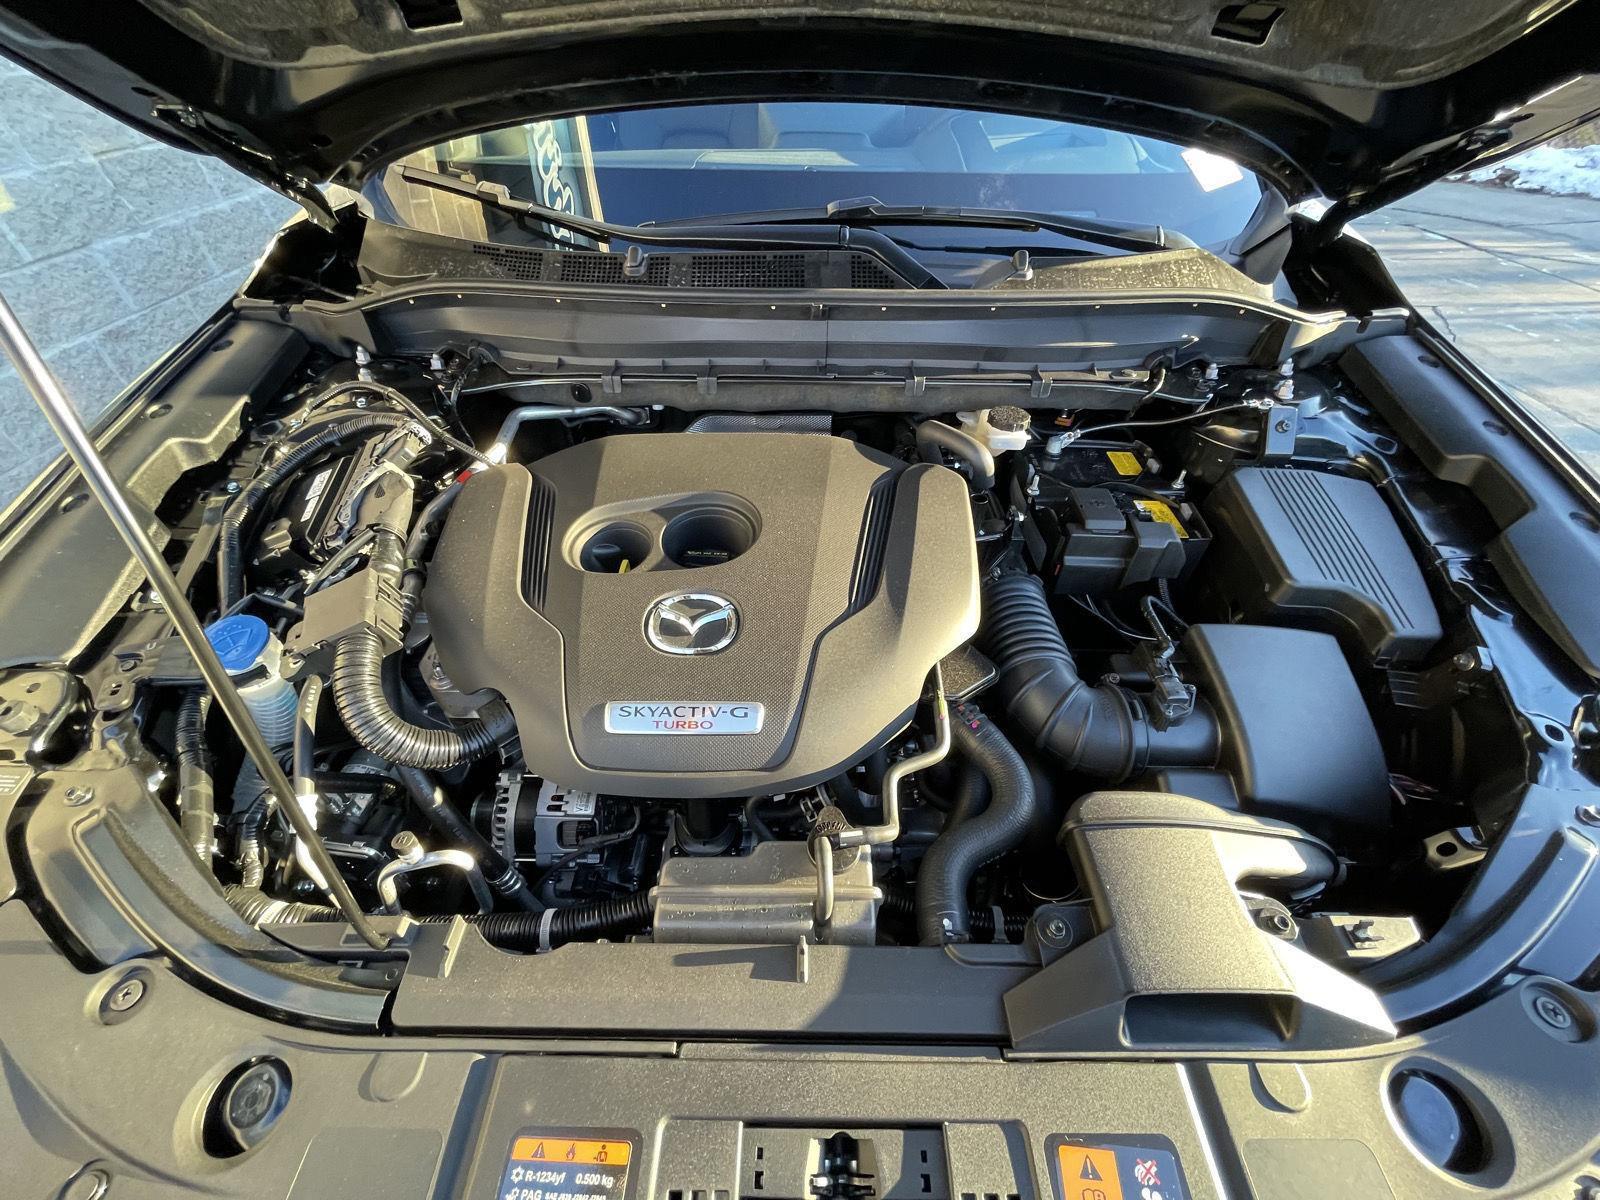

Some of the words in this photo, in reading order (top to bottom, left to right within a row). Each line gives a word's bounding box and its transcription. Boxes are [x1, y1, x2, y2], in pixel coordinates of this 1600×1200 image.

[618, 705, 749, 719] SKYACTIV-G
[652, 720, 714, 730] TURBO
[525, 1170, 567, 1186] R-1234yf
[575, 1172, 601, 1186] 0.500
[601, 1174, 614, 1189] kg
[520, 1189, 542, 1200] PAG
